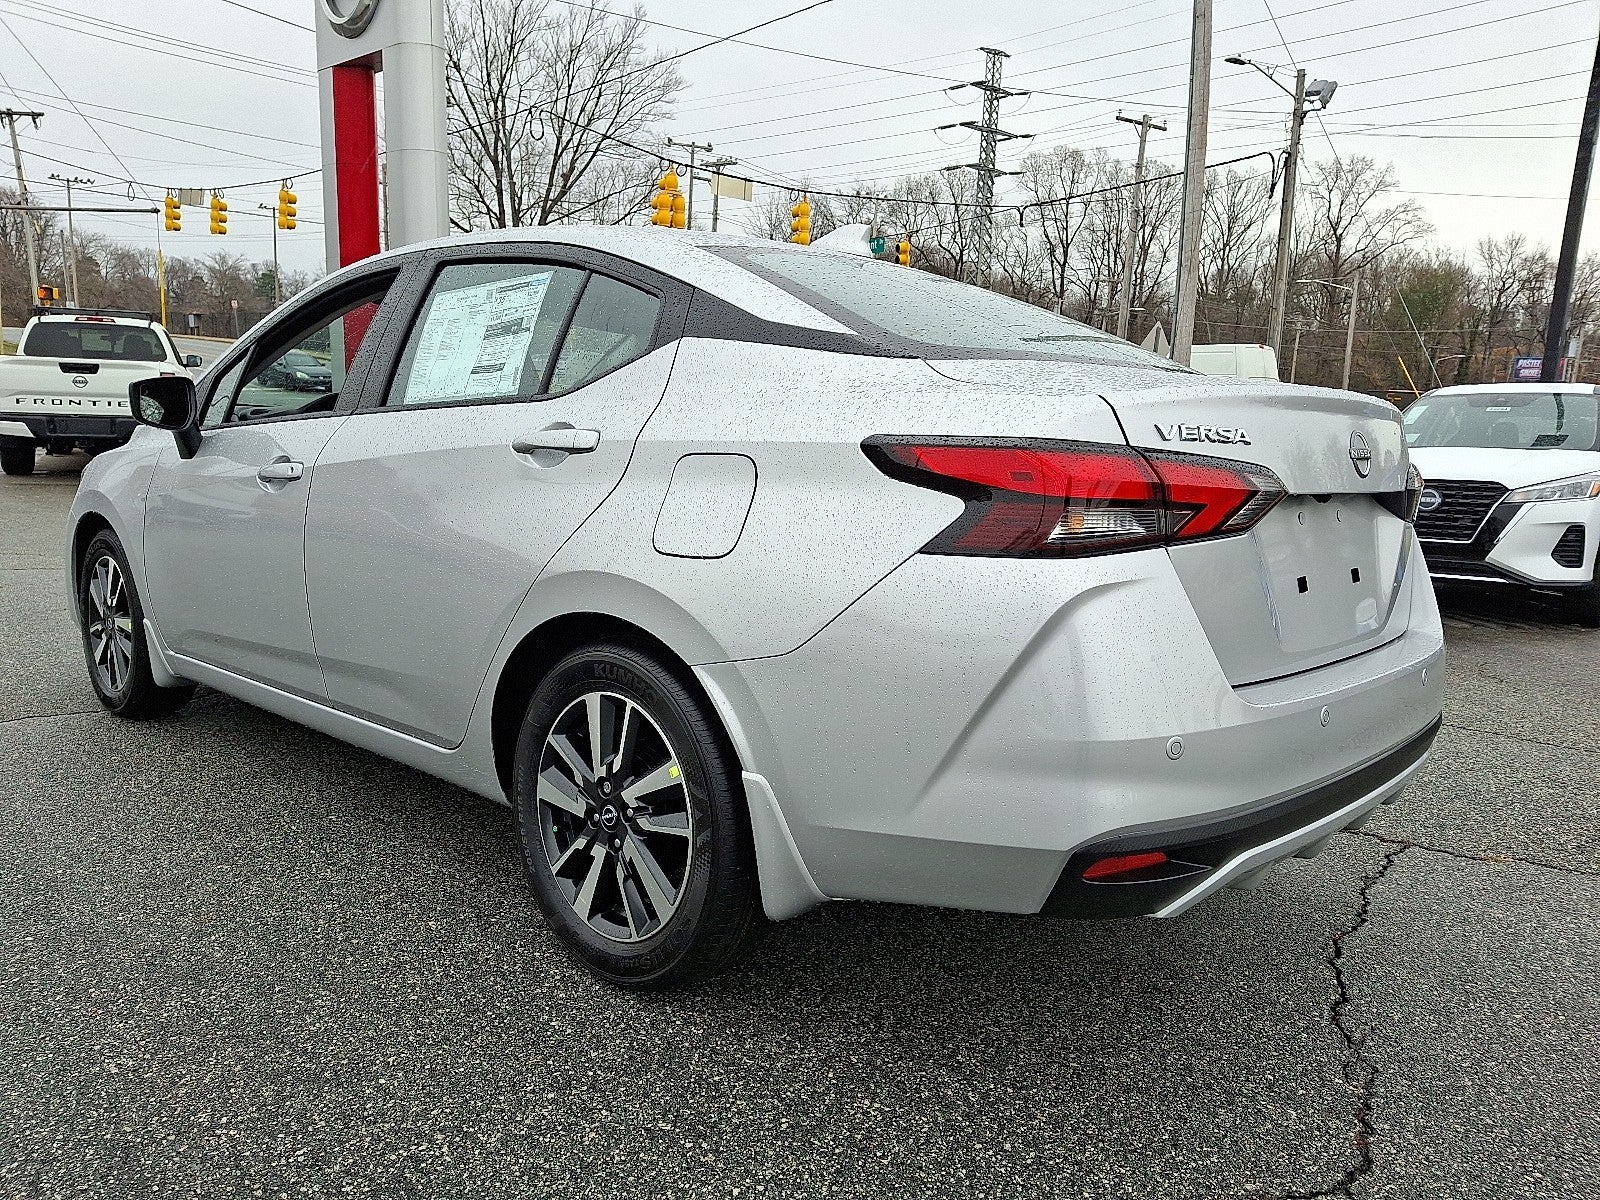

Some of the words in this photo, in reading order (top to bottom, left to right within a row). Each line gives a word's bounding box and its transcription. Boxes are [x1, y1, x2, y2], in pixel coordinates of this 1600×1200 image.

[15, 398, 129, 408] FRONTIE
[1154, 423, 1251, 445] VERSA
[593, 663, 659, 706] KUMHO
